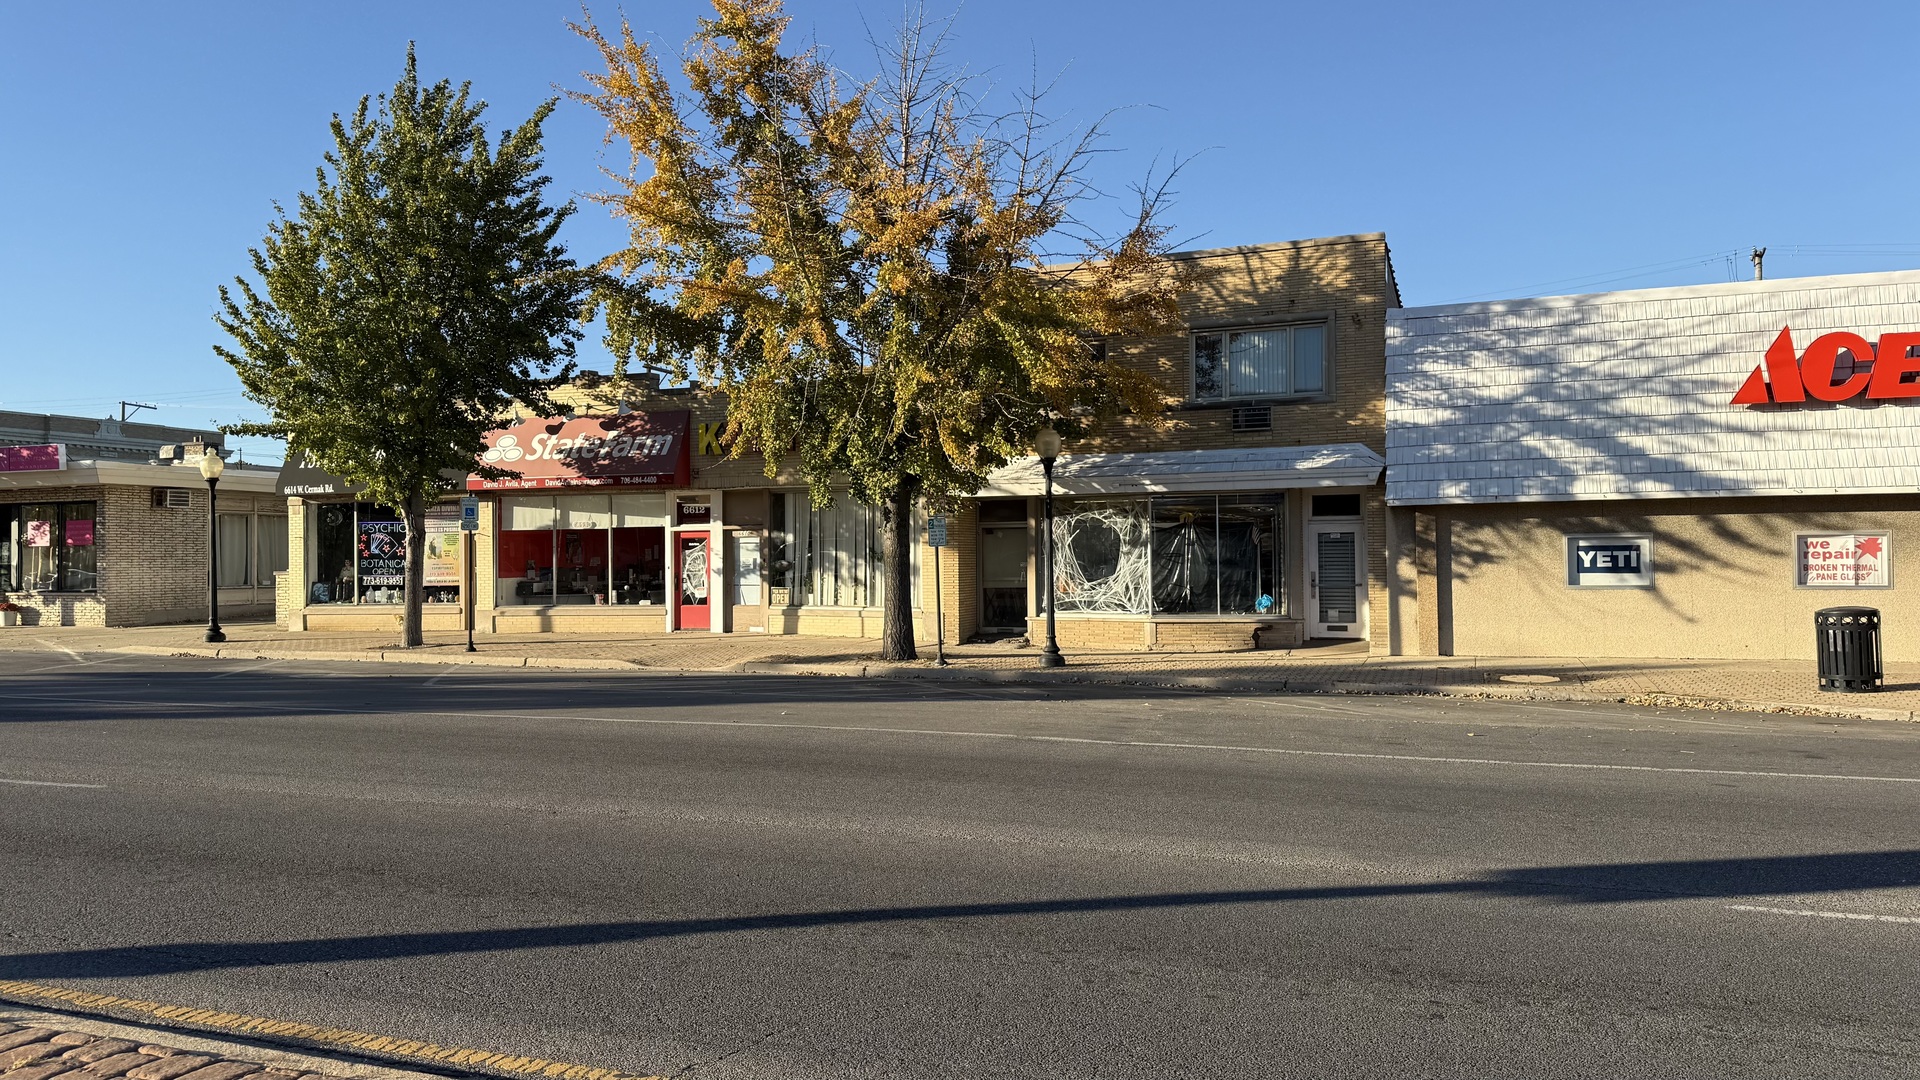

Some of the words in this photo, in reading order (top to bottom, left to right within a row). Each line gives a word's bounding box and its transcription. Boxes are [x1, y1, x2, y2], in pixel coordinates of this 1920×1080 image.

[1730, 325, 1920, 405] ACE
[521, 480, 537, 489] Agent
[284, 486, 296, 495] 6614
[304, 484, 324, 493] Cermak
[325, 484, 334, 493] Rd.
[683, 506, 705, 514] 6612
[361, 523, 406, 533] PSYCHIC
[1803, 540, 1830, 549] we
[1578, 550, 1638, 568] YETI
[1803, 548, 1858, 562] repair
[361, 559, 406, 568] BOTANICA
[1803, 563, 1838, 572] BROKEN
[1841, 563, 1879, 572] THERMAL
[372, 567, 396, 575] OPEN
[1816, 573, 1838, 581] PANE
[1841, 573, 1866, 581] GLASS
[772, 593, 789, 604] OPEN
